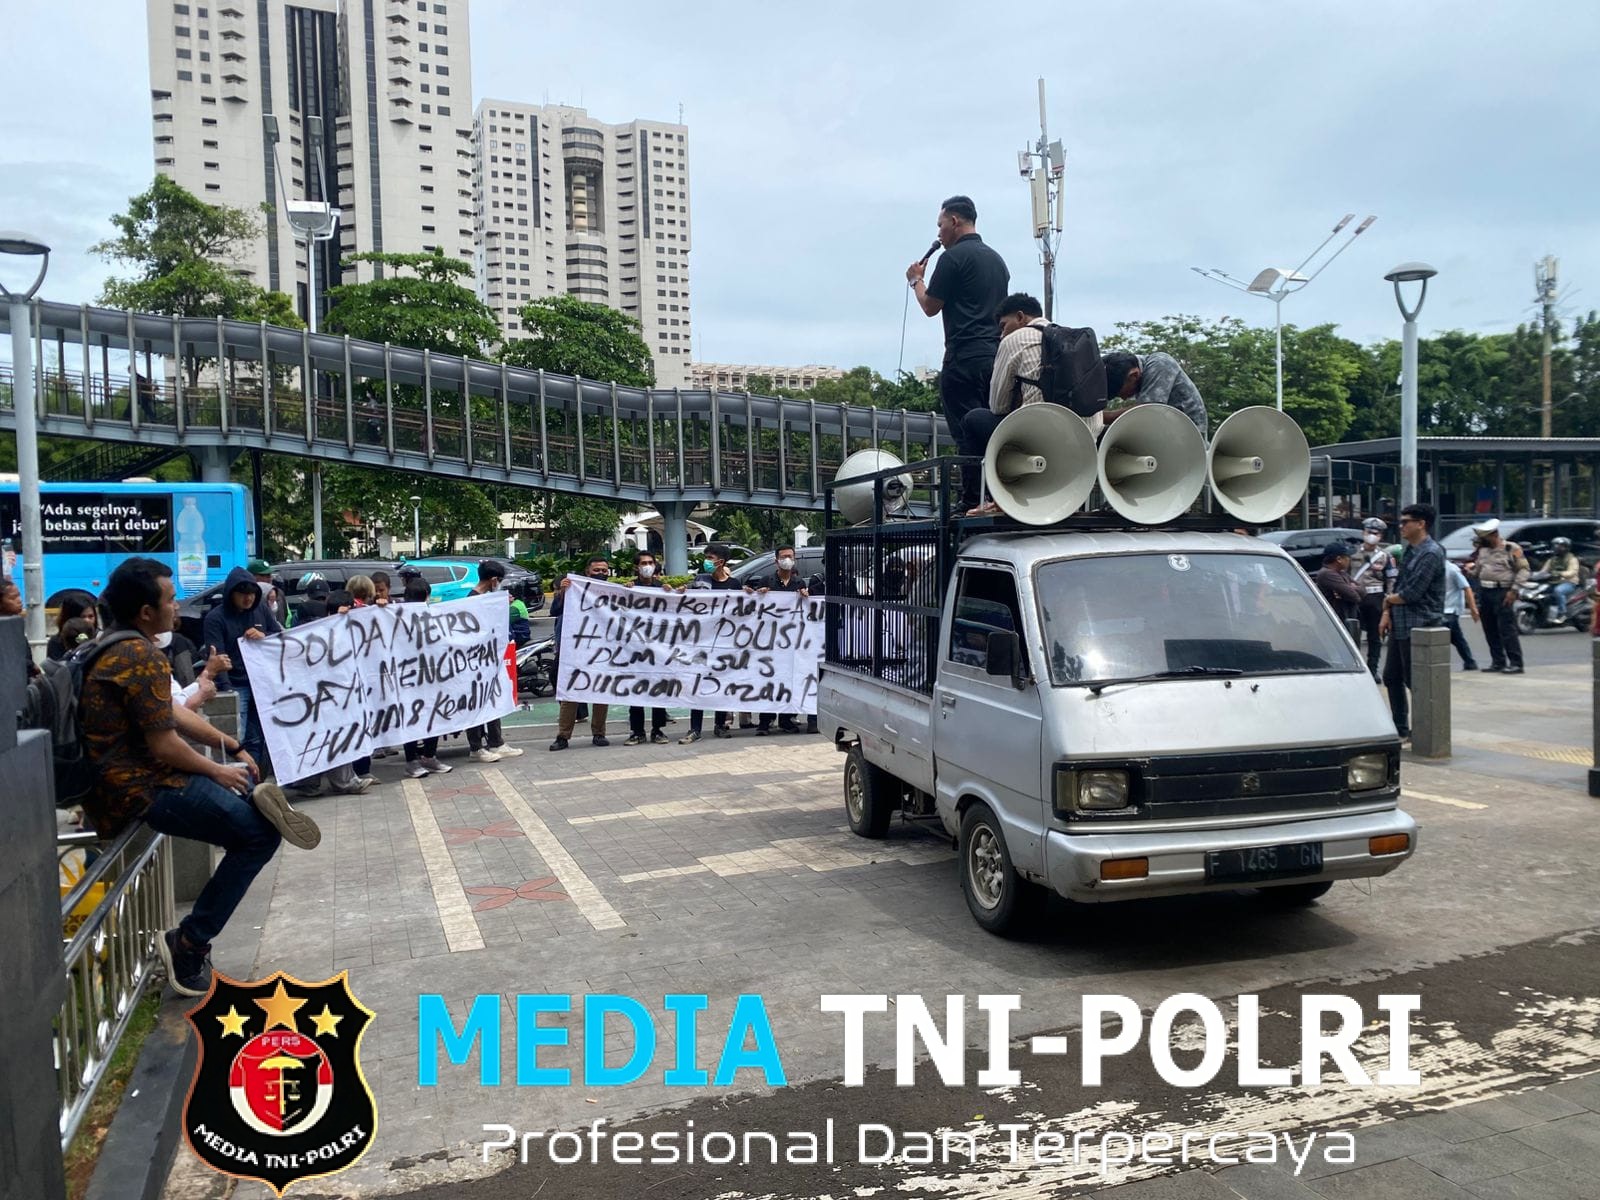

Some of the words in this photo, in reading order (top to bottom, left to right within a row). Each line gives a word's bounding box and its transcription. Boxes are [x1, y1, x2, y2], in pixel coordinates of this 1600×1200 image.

[45, 519, 88, 532] bebas
[91, 519, 120, 532] dari
[77, 503, 143, 519] segelnya,
[580, 581, 668, 613] Lawan
[277, 616, 386, 683] POLDA
[390, 607, 480, 650] METRO
[573, 615, 703, 650] HUKUM
[297, 702, 405, 774] HUKUM
[1210, 852, 1221, 877] F
[1238, 847, 1280, 872] 1465
